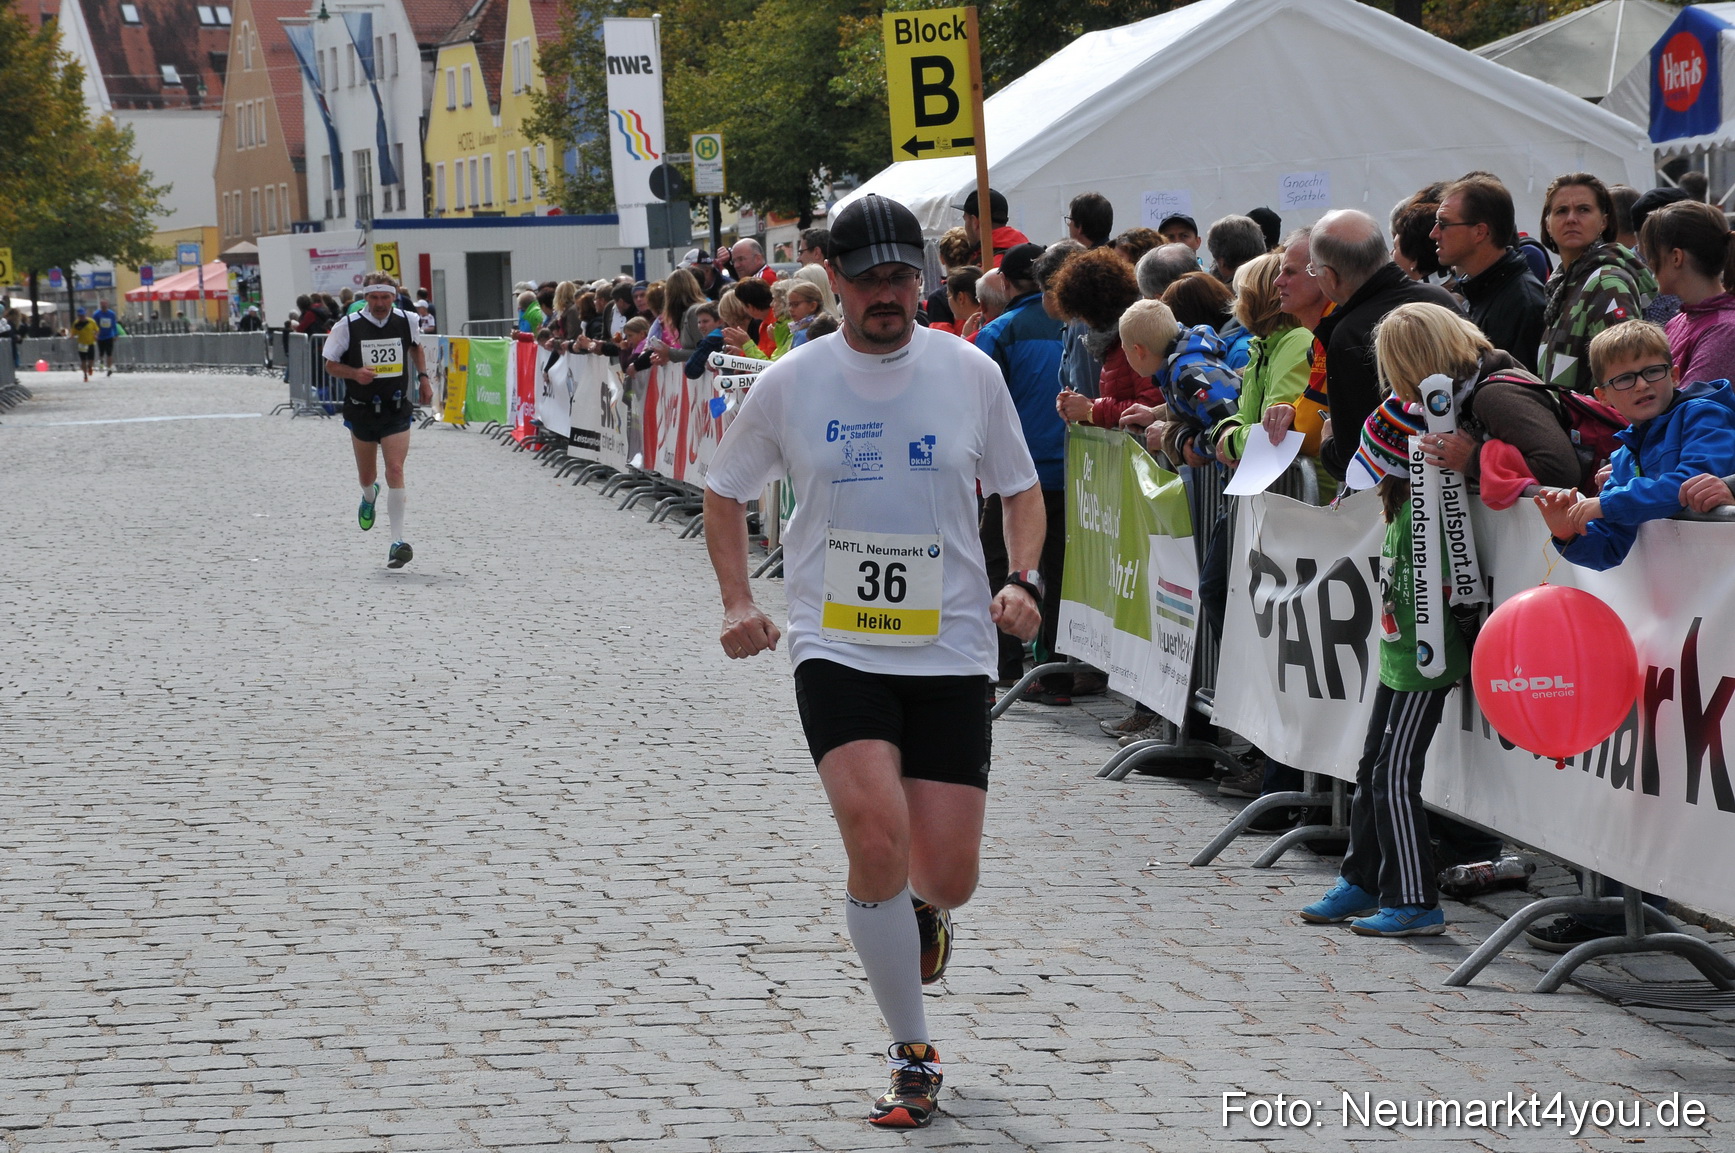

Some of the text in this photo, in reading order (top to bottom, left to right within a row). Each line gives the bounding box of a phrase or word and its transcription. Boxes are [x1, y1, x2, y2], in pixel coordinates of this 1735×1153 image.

[894, 14, 968, 45] Block
[911, 55, 960, 128] B
[701, 142, 713, 155] H
[1283, 174, 1323, 188] Gnocchi
[1286, 190, 1326, 205] Spätzle
[381, 253, 394, 271] D
[371, 348, 396, 363] 323
[739, 377, 757, 388] BM
[841, 421, 884, 432] Neumarkter
[849, 430, 883, 440] Stadtlauf
[910, 457, 931, 466] DKMS
[1411, 450, 1431, 624] bmw-laufsport.de
[829, 539, 924, 557] PARTL Neumarkt
[857, 560, 907, 603] 36
[857, 612, 902, 631] Heiko
[1532, 686, 1575, 699] energie
